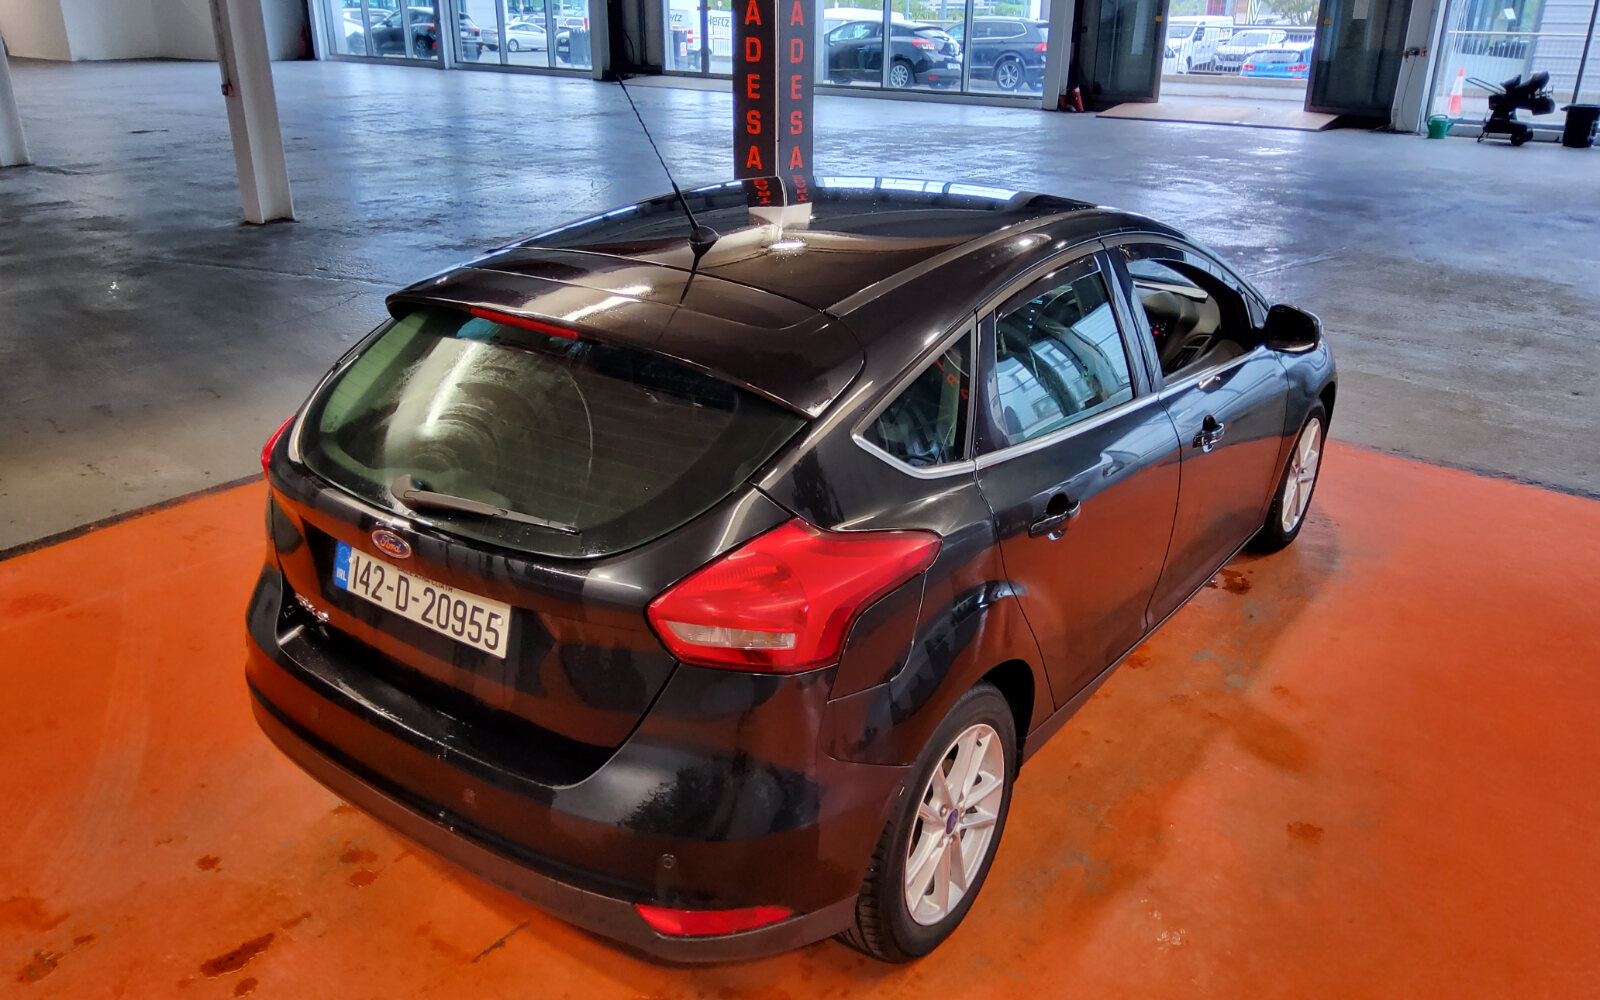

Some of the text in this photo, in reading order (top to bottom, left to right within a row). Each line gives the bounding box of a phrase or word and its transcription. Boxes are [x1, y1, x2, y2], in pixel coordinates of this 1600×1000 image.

[745, 0, 762, 170] ADESA
[790, 1, 804, 171] ADESA
[336, 567, 347, 582] IRL
[379, 534, 402, 553] Ford
[352, 555, 504, 651] 142-D-20955
